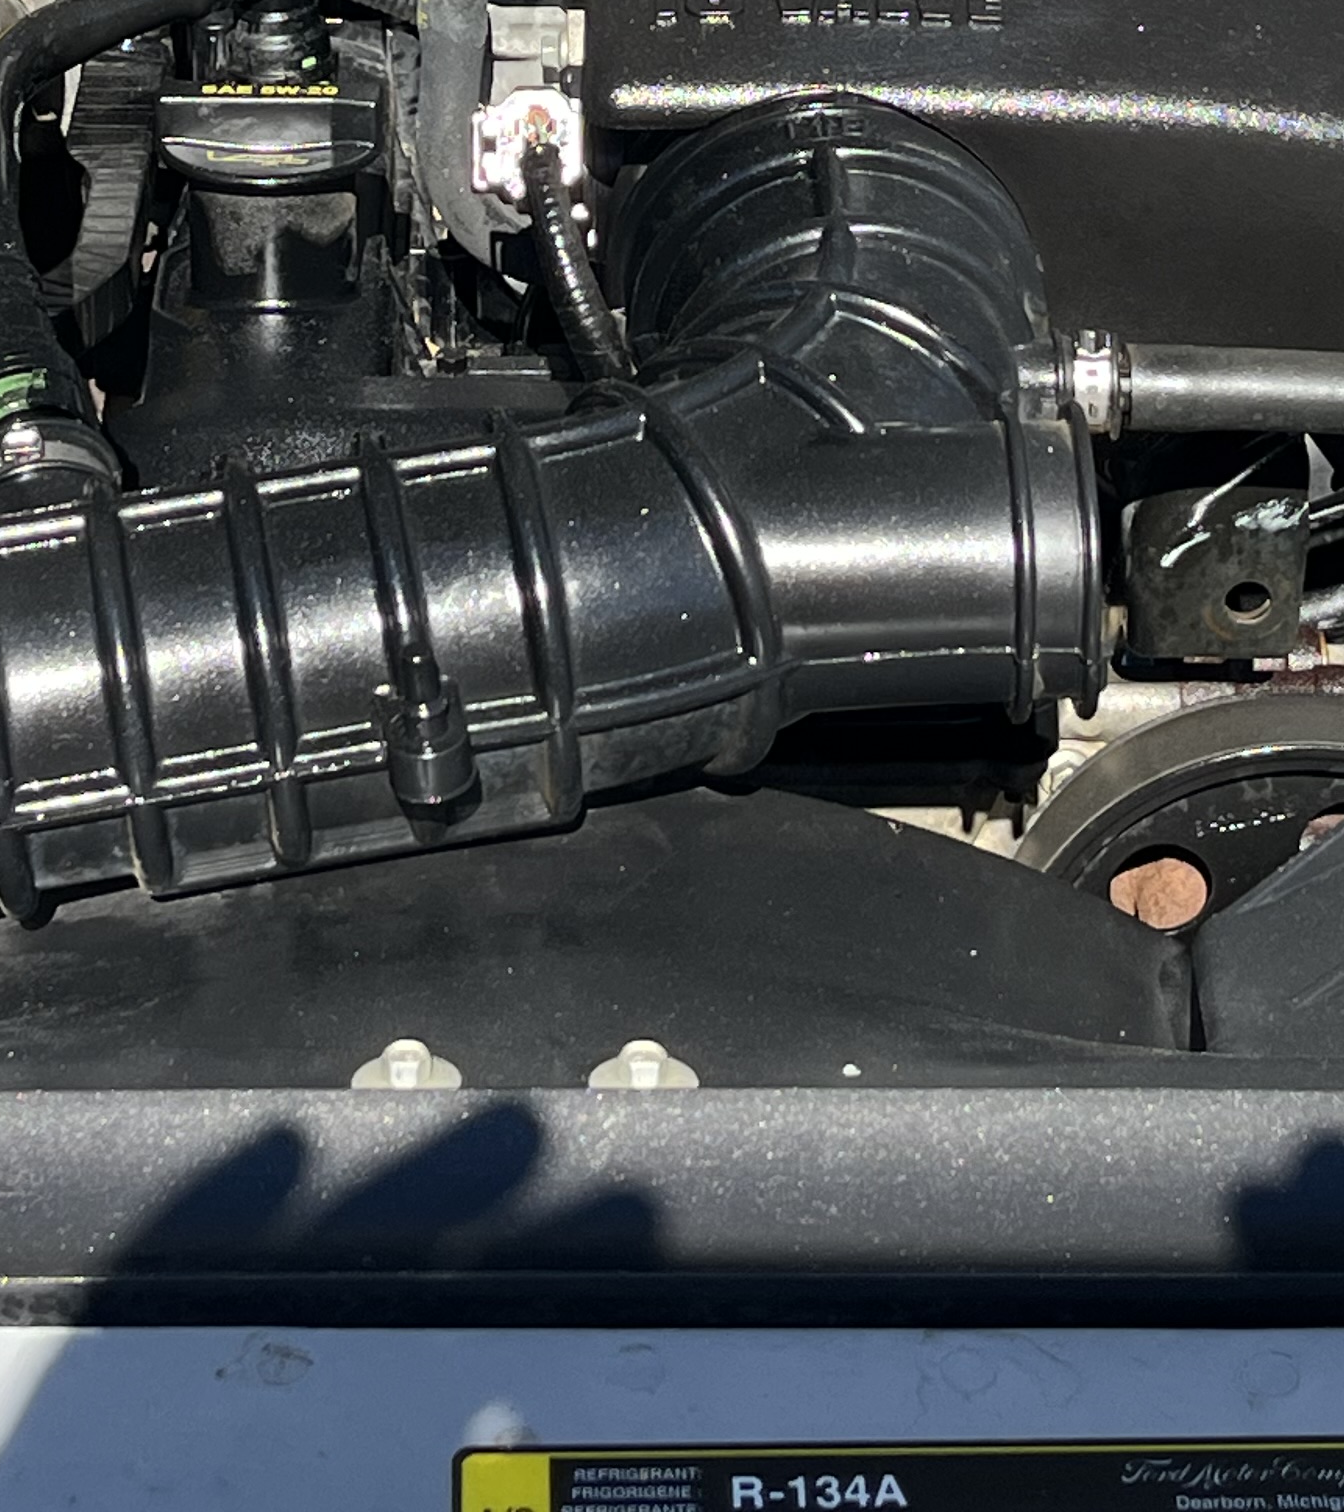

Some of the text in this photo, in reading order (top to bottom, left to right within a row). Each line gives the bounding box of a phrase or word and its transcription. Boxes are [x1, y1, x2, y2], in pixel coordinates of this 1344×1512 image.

[202, 84, 339, 96] SAE 5W-20
[1121, 1457, 1193, 1484] Ford
[1185, 1461, 1275, 1489] Motor
[730, 1474, 908, 1509] R-134A
[1175, 1494, 1273, 1510] Dearborn,
